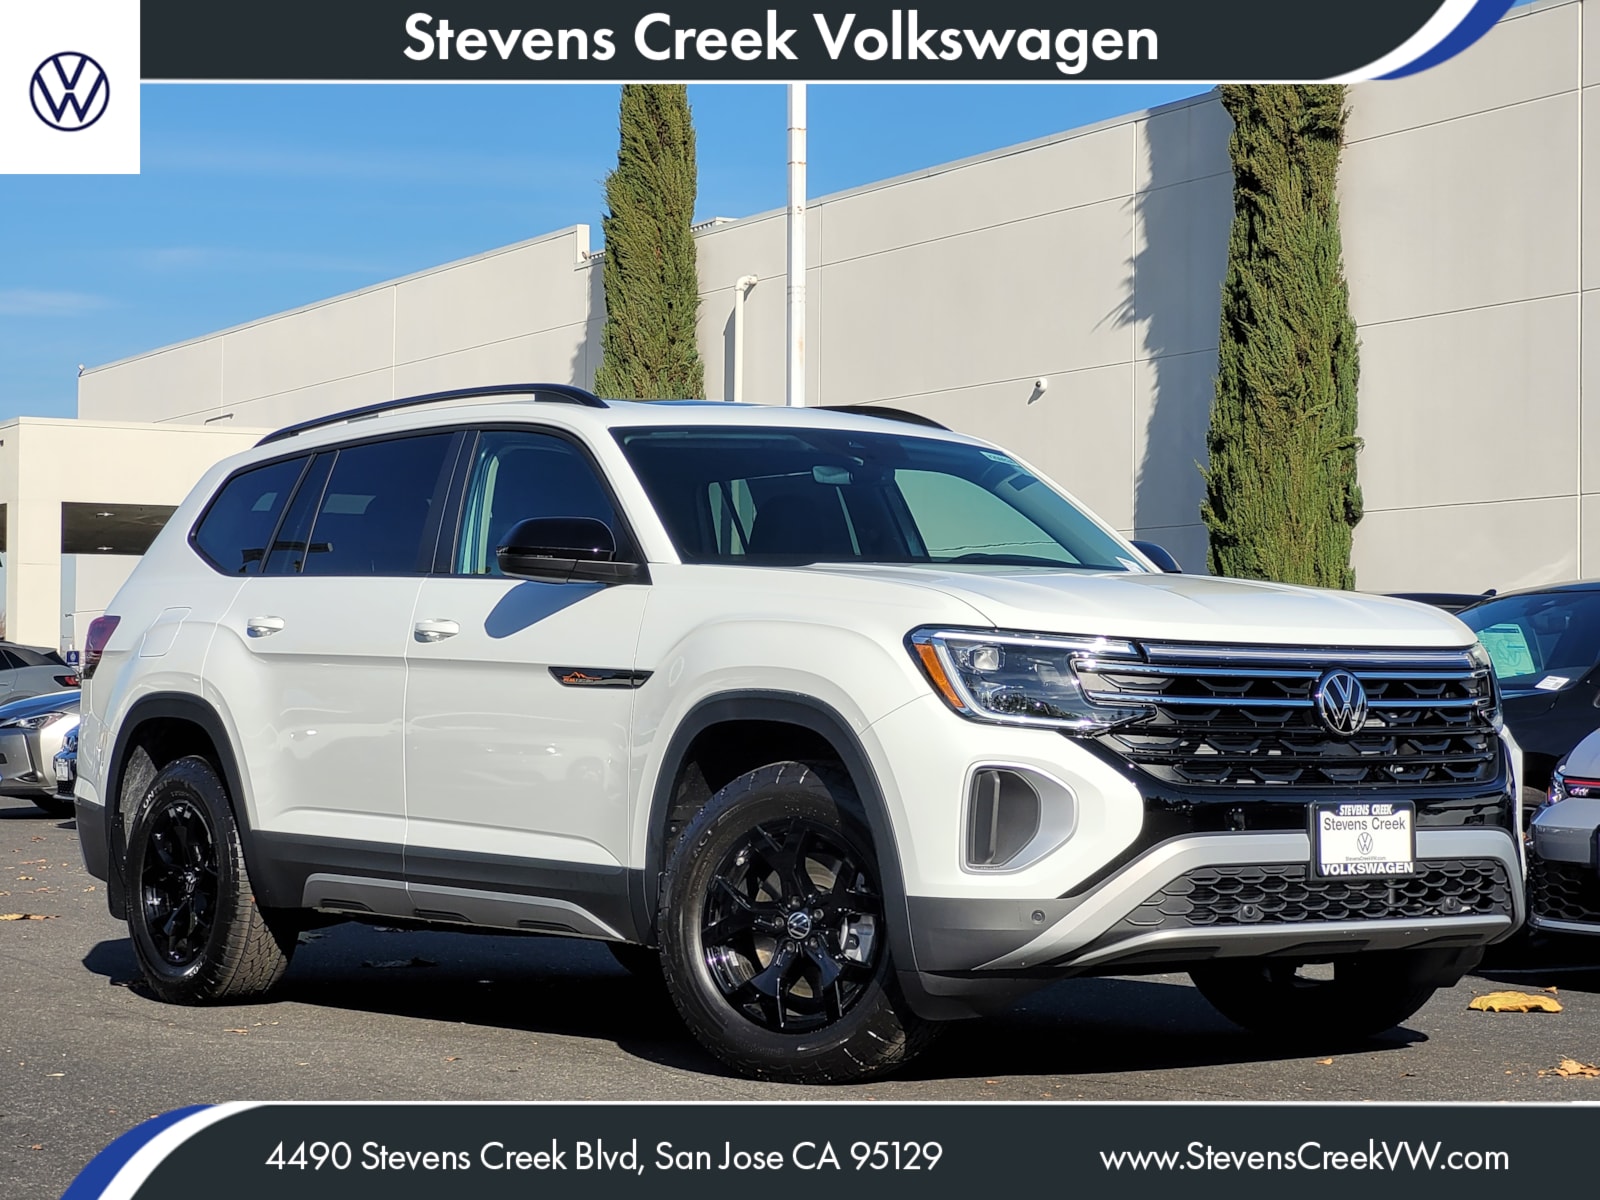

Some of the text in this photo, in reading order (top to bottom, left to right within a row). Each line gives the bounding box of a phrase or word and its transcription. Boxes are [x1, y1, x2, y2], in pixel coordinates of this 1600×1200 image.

[1339, 803, 1393, 816] STEVENS CREEK
[1323, 816, 1406, 831] Stevens Creek
[1321, 862, 1414, 876] VOLKSWAGEN
